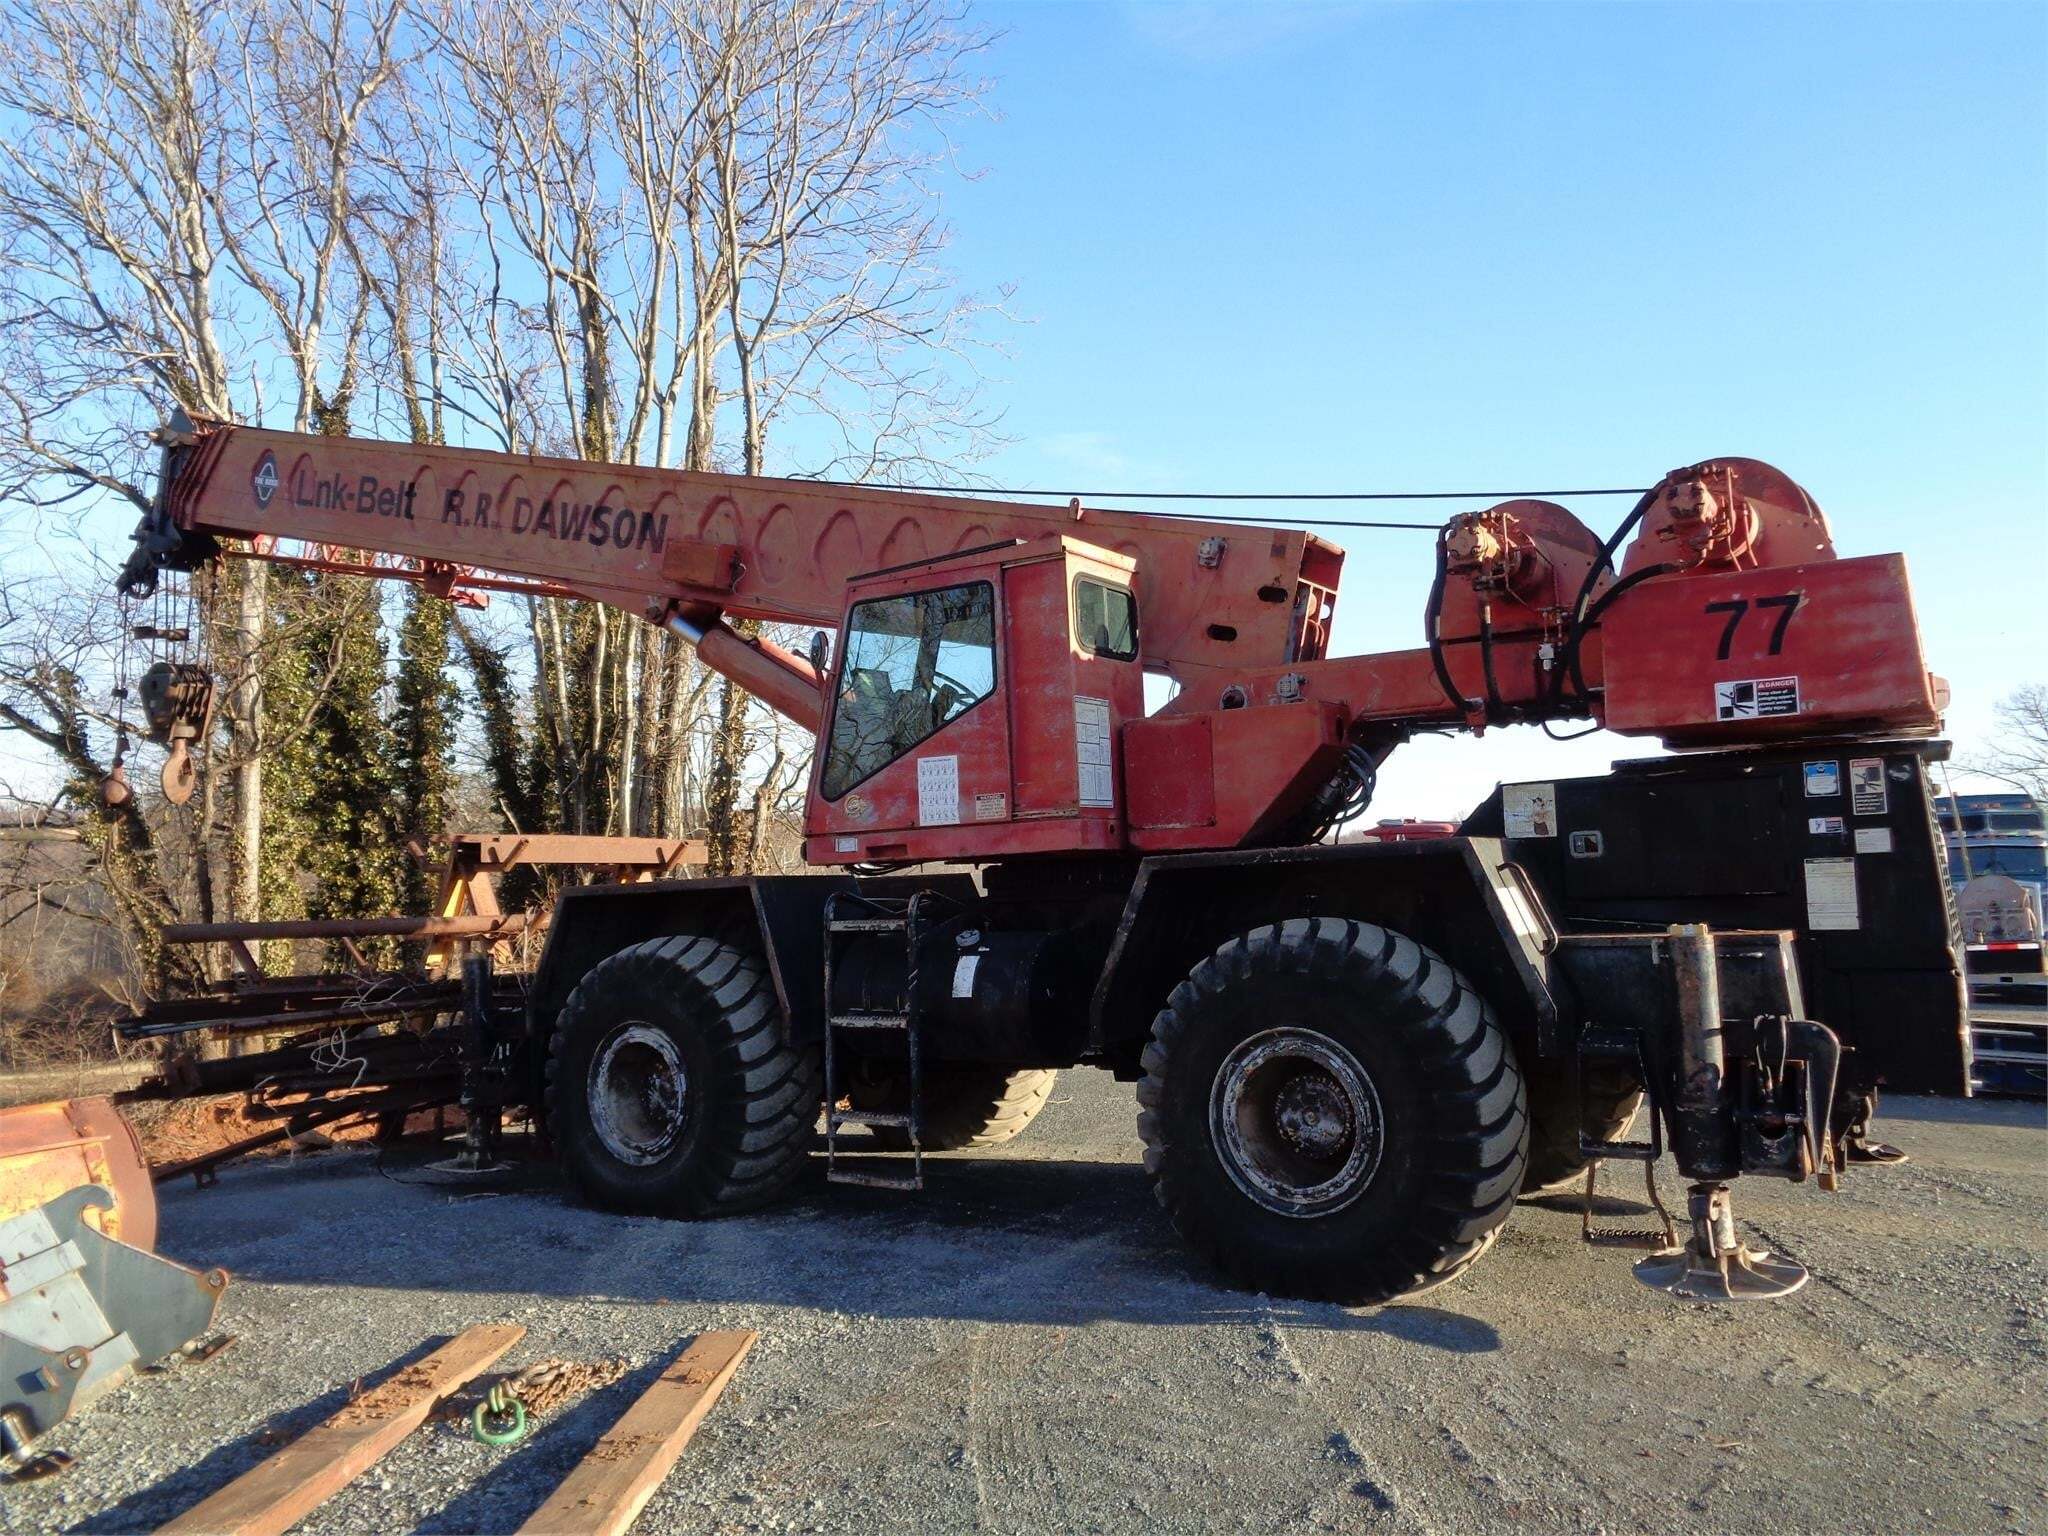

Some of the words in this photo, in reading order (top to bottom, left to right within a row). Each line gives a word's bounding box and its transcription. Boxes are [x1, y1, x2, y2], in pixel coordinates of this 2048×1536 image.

[295, 470, 417, 520] Lnk-Belt
[511, 496, 669, 553] DAWSON
[1704, 593, 1801, 661] 77
[1765, 680, 1795, 688] DANGER
